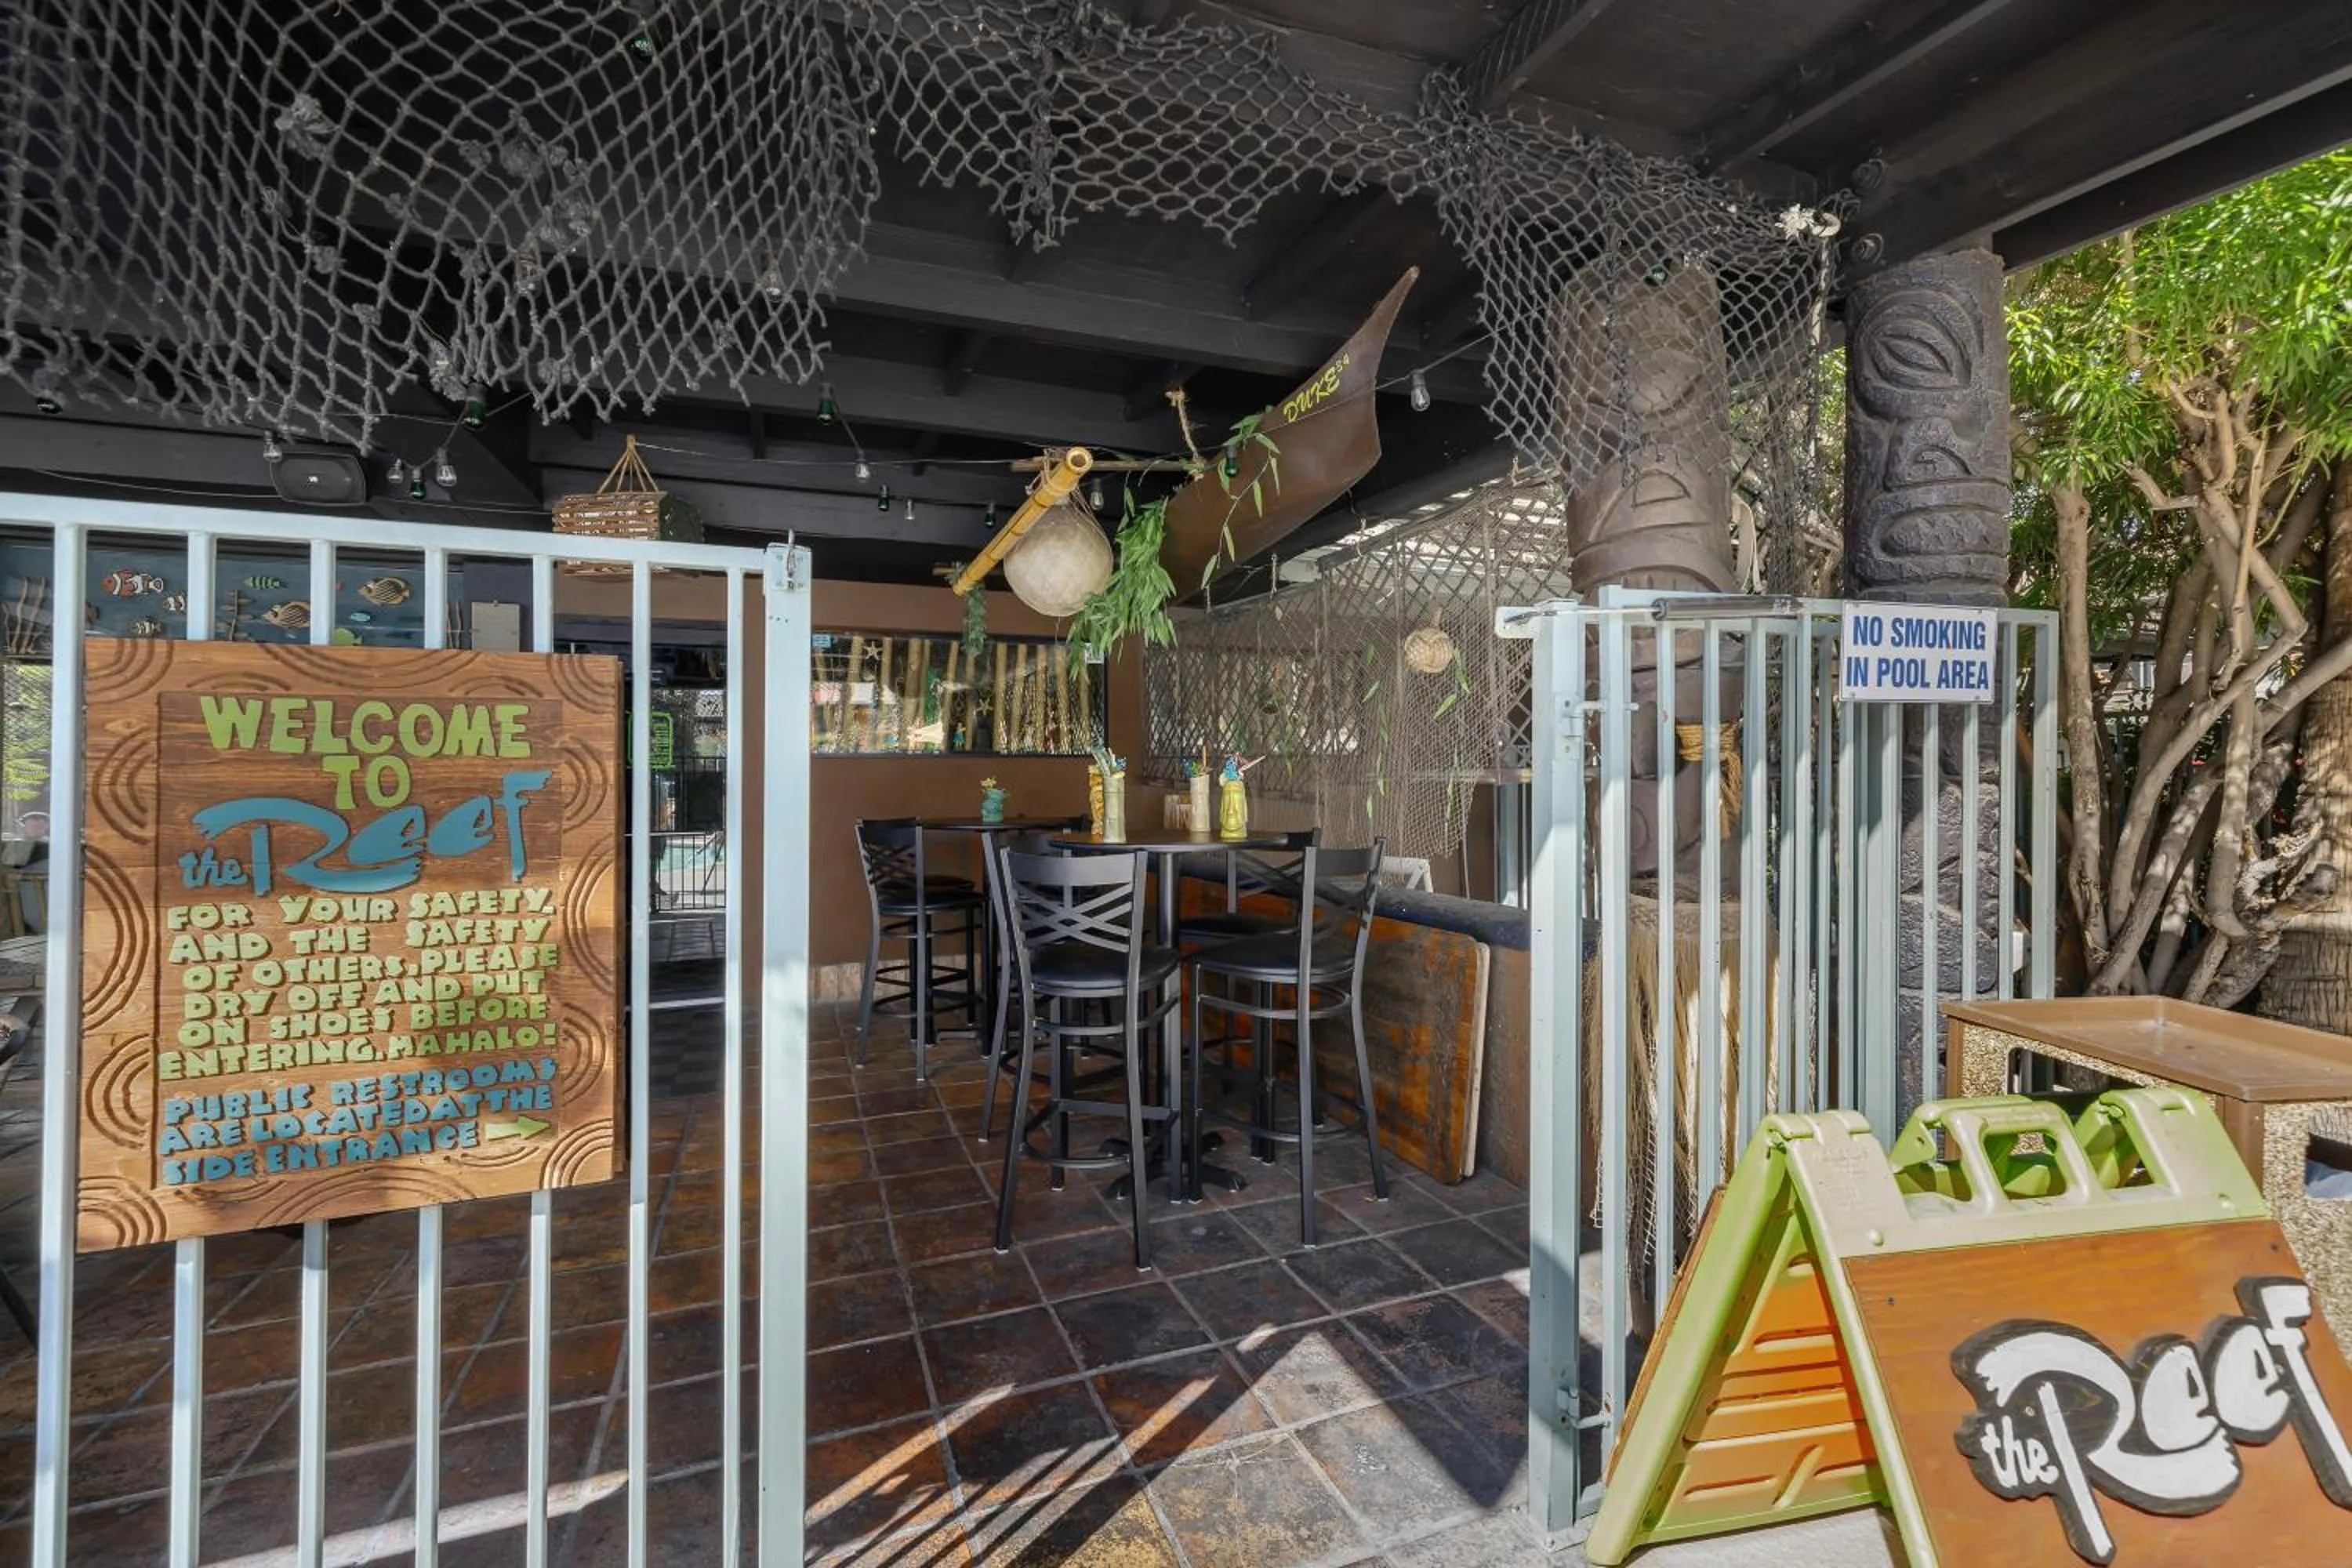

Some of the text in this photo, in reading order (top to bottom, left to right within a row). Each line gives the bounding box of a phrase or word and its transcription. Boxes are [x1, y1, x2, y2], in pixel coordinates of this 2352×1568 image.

[1853, 616, 1986, 650] NO SMOKING
[1846, 657, 1989, 689] IN POOL AREA
[199, 695, 532, 759] WELCOME
[322, 754, 412, 810] TO
[177, 771, 552, 898] the Reef
[167, 903, 252, 931] FOR
[278, 895, 398, 924] YOUR
[169, 918, 550, 964] AND THE SAFETY
[183, 963, 242, 993] OF
[421, 943, 557, 975] PLEASE
[178, 994, 548, 1048] ON SHOES BEFORE
[184, 970, 545, 1021] DRY OFF AND PUT
[388, 1022, 557, 1061] MAHALO!
[165, 1057, 556, 1127] PUBLIC RESTROOMS
[159, 1083, 554, 1156] ARE LOCATED AT THE
[163, 1120, 480, 1186] SIDE ENTRANCE
[1980, 1414, 2059, 1490] the
